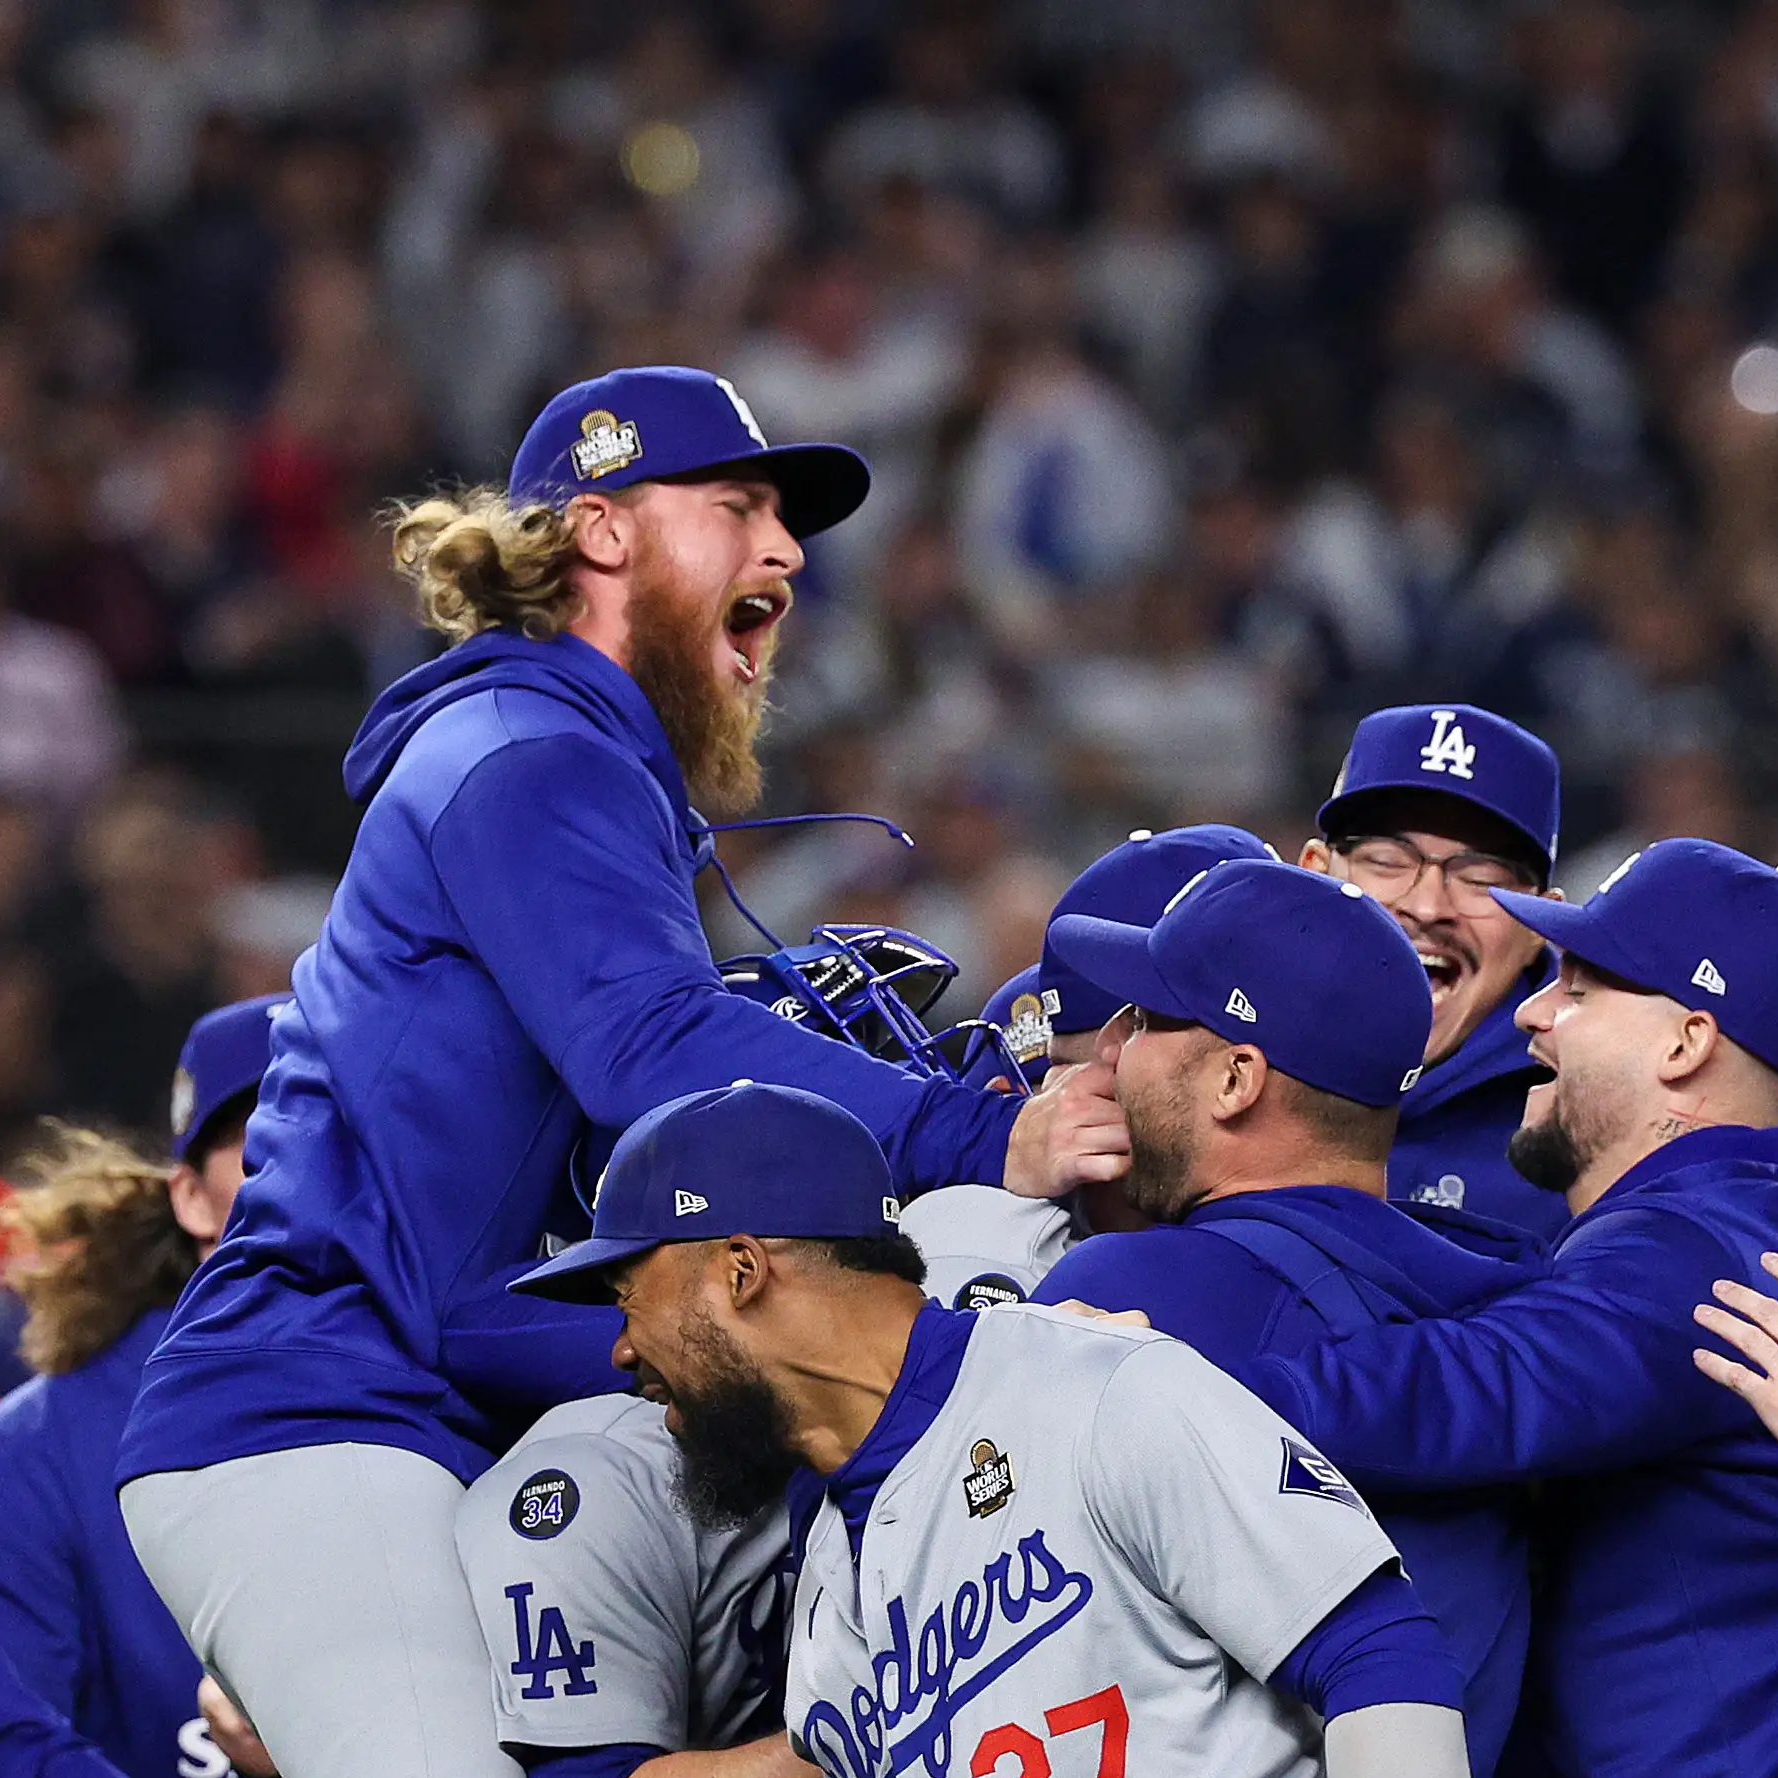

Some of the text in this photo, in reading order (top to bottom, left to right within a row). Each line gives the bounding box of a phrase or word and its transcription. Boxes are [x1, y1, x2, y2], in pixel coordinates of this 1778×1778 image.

[1421, 710, 1476, 780] LA
[969, 1284, 1019, 1304] FERNANDO
[966, 1461, 1008, 1494] WORLD
[970, 1474, 1010, 1506] SERIES
[521, 1492, 564, 1529] 34
[504, 1581, 597, 1700] LA
